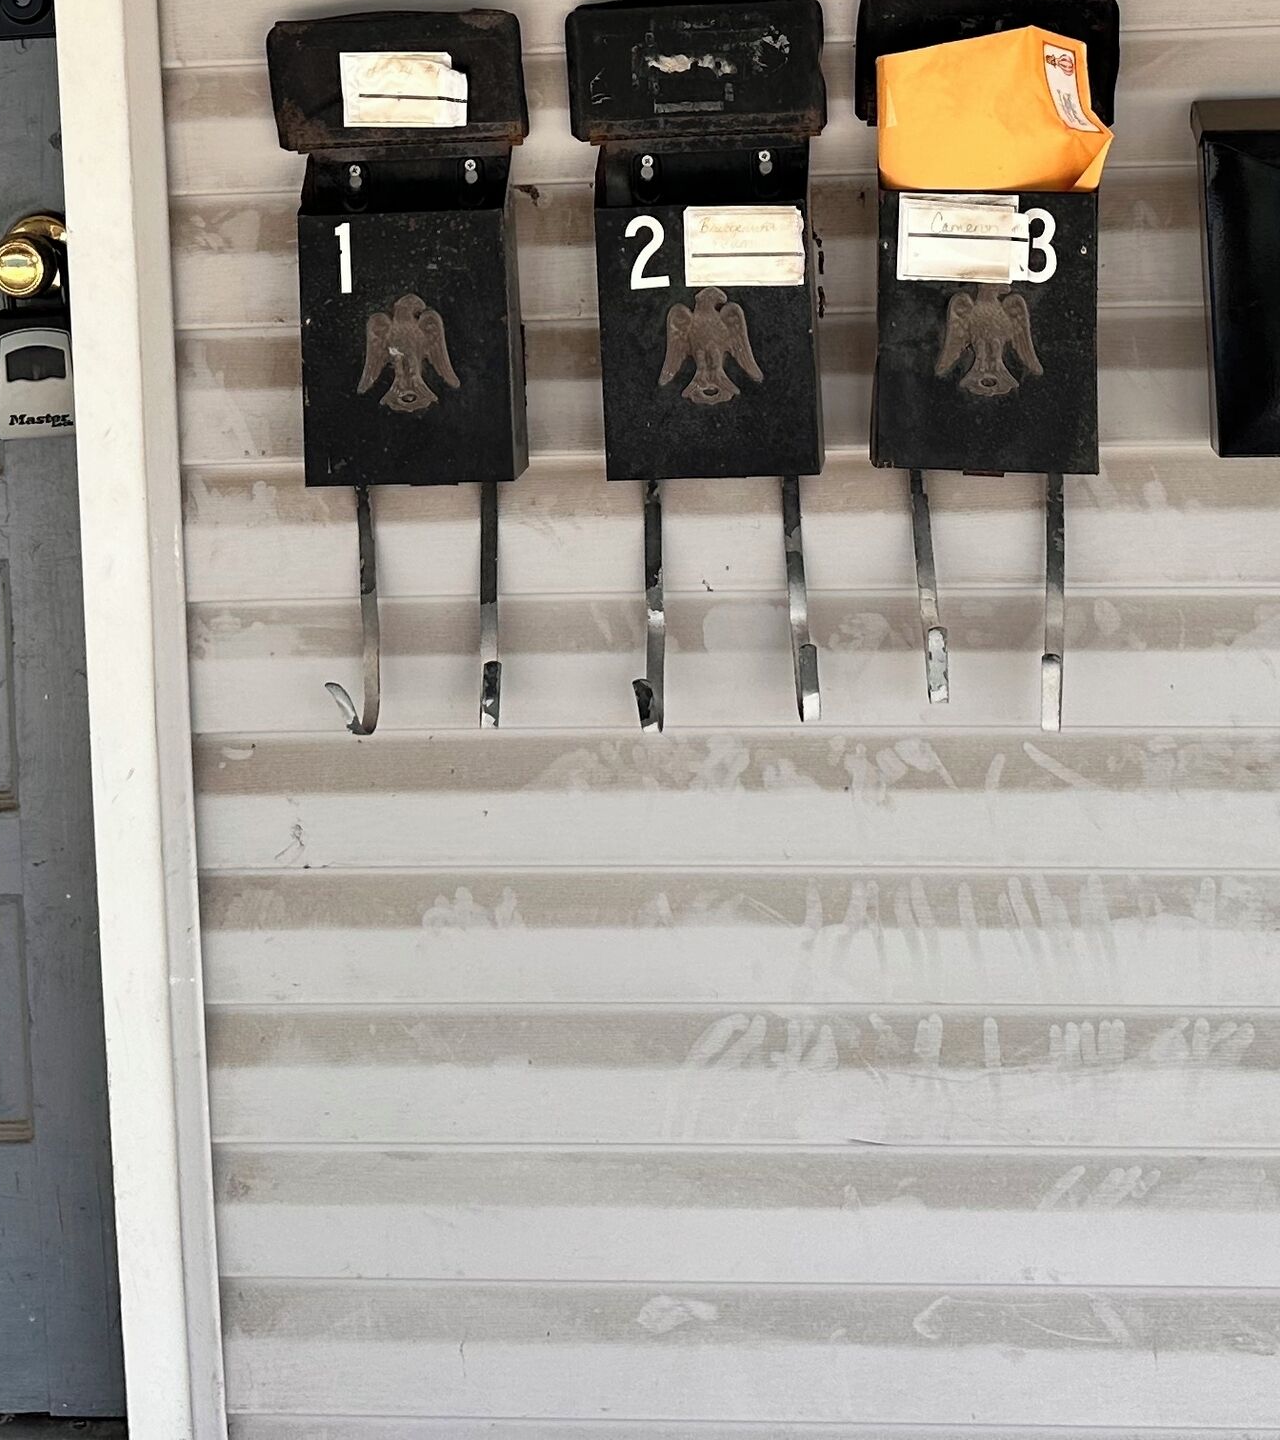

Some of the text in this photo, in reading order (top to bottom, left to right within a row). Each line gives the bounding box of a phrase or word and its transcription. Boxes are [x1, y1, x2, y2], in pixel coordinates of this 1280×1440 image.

[334, 222, 353, 294] 1
[624, 215, 671, 290] 2
[1024, 207, 1058, 284] 3
